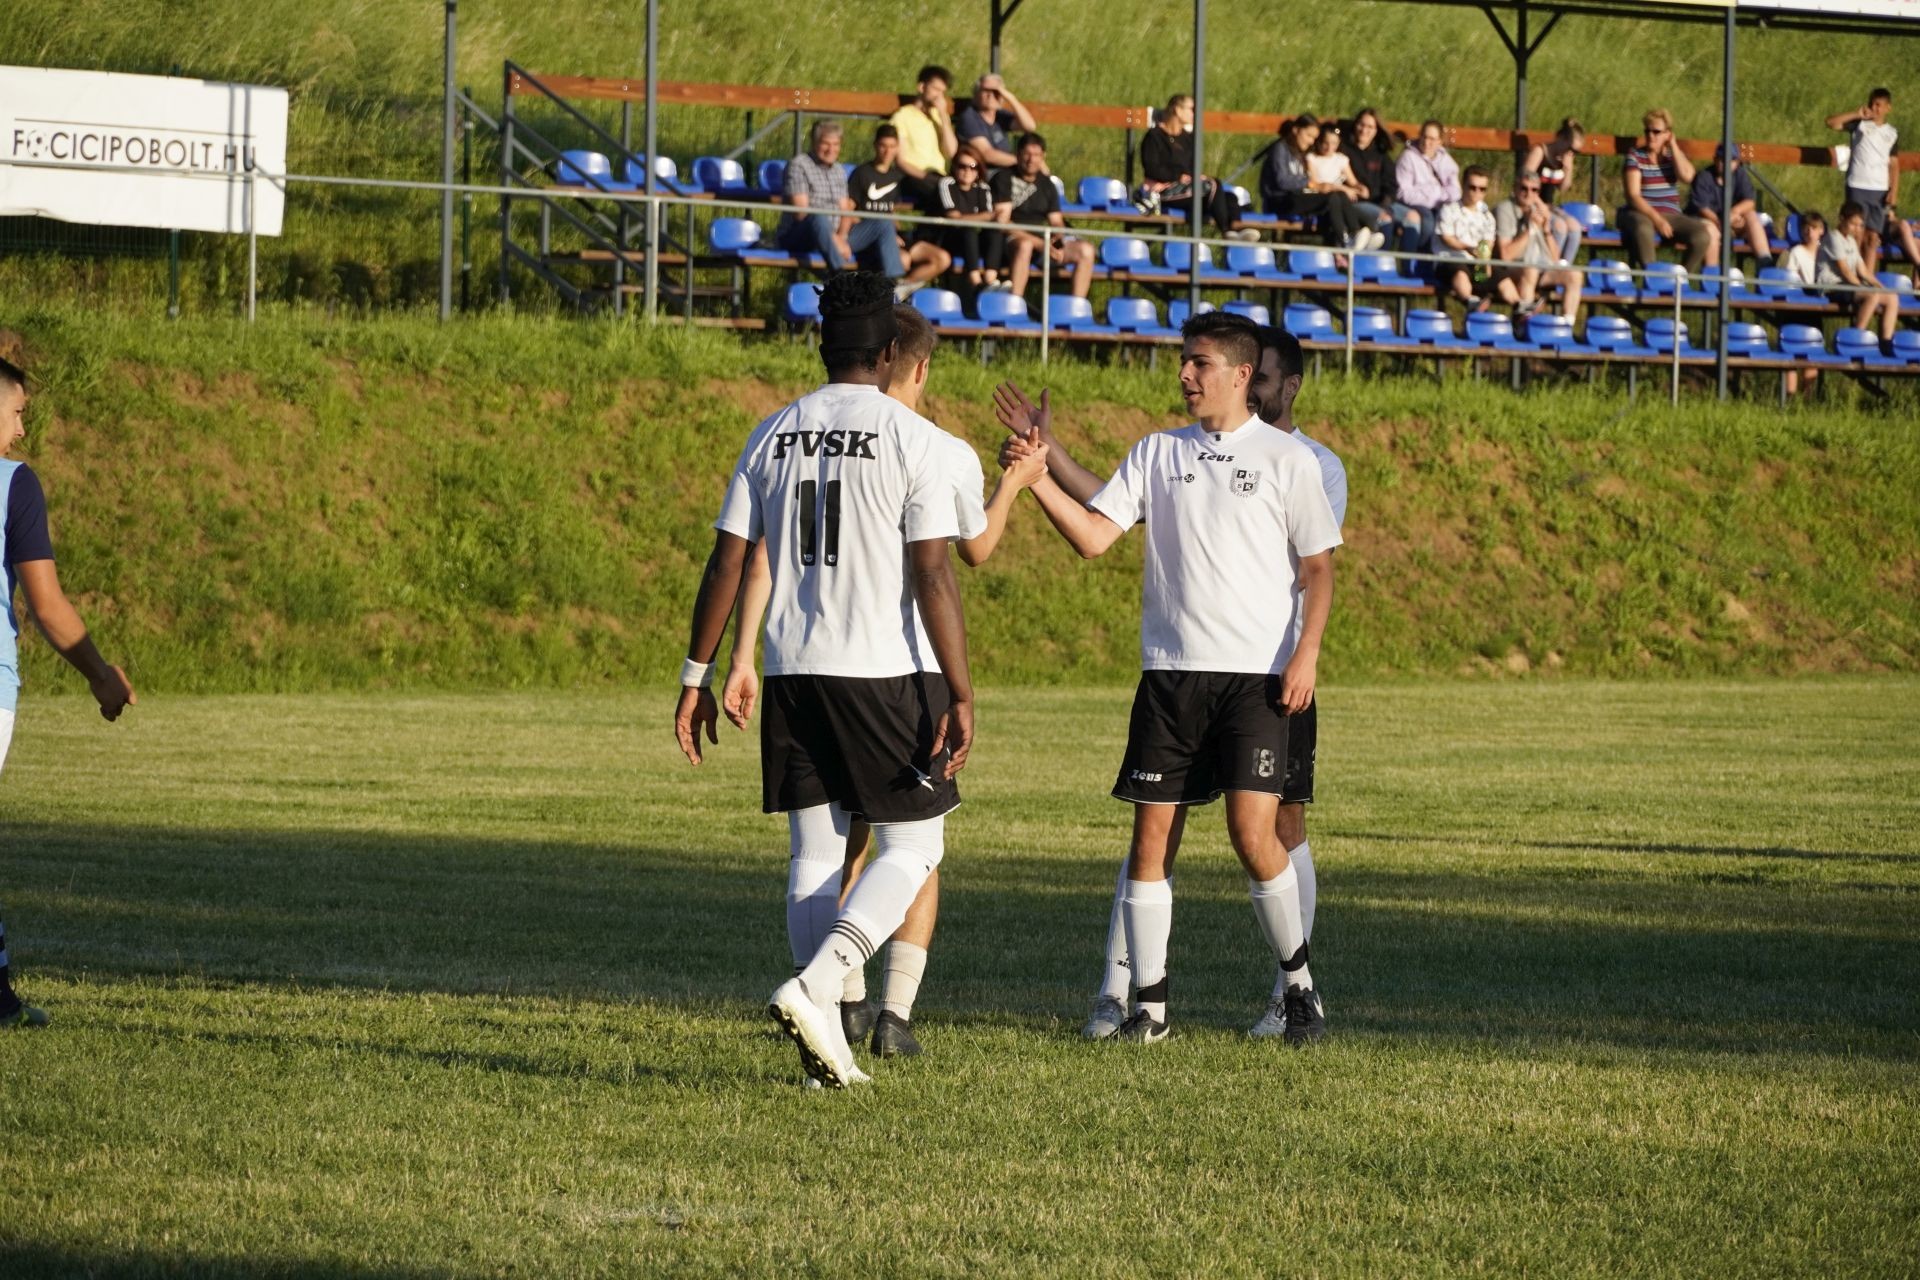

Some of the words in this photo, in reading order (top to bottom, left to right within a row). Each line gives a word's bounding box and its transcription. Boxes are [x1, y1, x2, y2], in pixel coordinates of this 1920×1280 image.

[773, 430, 878, 460] PVSK
[1197, 452, 1235, 463] Zeus
[796, 480, 841, 566] 11
[1131, 769, 1163, 782] Zeus
